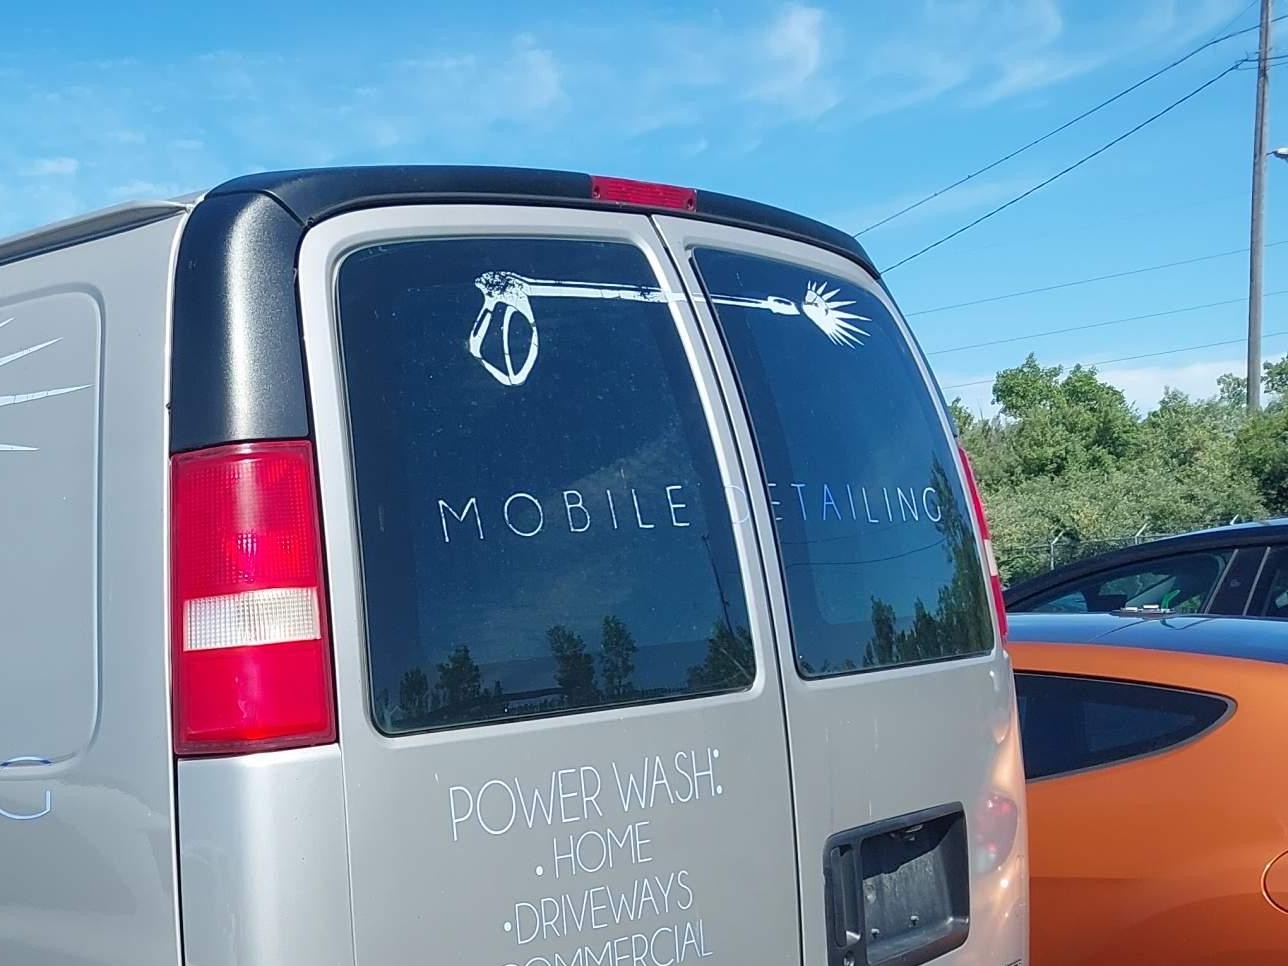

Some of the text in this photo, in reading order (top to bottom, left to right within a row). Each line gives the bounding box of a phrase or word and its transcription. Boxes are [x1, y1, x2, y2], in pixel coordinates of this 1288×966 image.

[439, 483, 943, 543] MOBILE DETAILING
[448, 747, 723, 841] POWER WASH:
[552, 820, 654, 879] HOME
[514, 869, 694, 945] DRIVEWAYS
